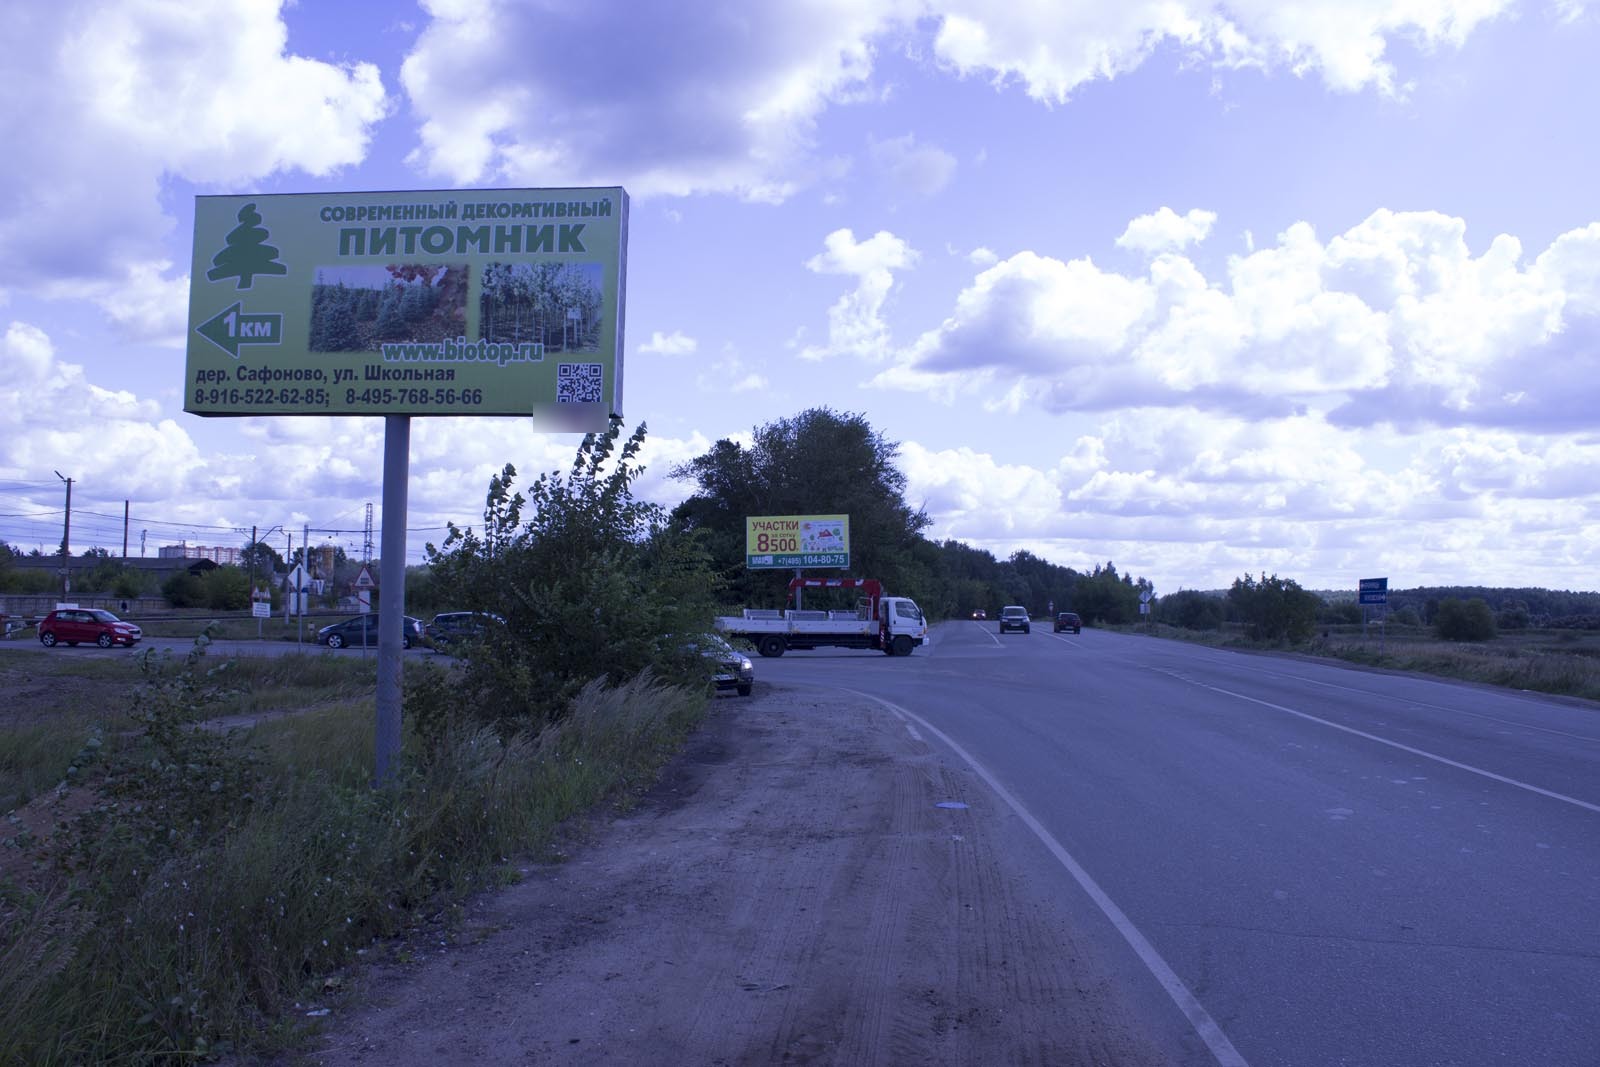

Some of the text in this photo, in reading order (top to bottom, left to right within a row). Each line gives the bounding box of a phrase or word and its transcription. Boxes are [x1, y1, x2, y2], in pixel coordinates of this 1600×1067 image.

[320, 198, 611, 222] СОВРЕМЕННЫЙ ДЕКОРАТИВНЫЙ
[338, 223, 586, 256] ПИТОМНИК
[223, 311, 237, 337] 1
[382, 337, 544, 365] www.biotop.ru
[196, 364, 455, 384] дер. Сафоново, ул. Школьная
[194, 388, 482, 407] 8-916-522-62-85; 8-495-768-56-66
[752, 520, 799, 531] УЧАСТКИ
[803, 555, 845, 564] 104-80-75
